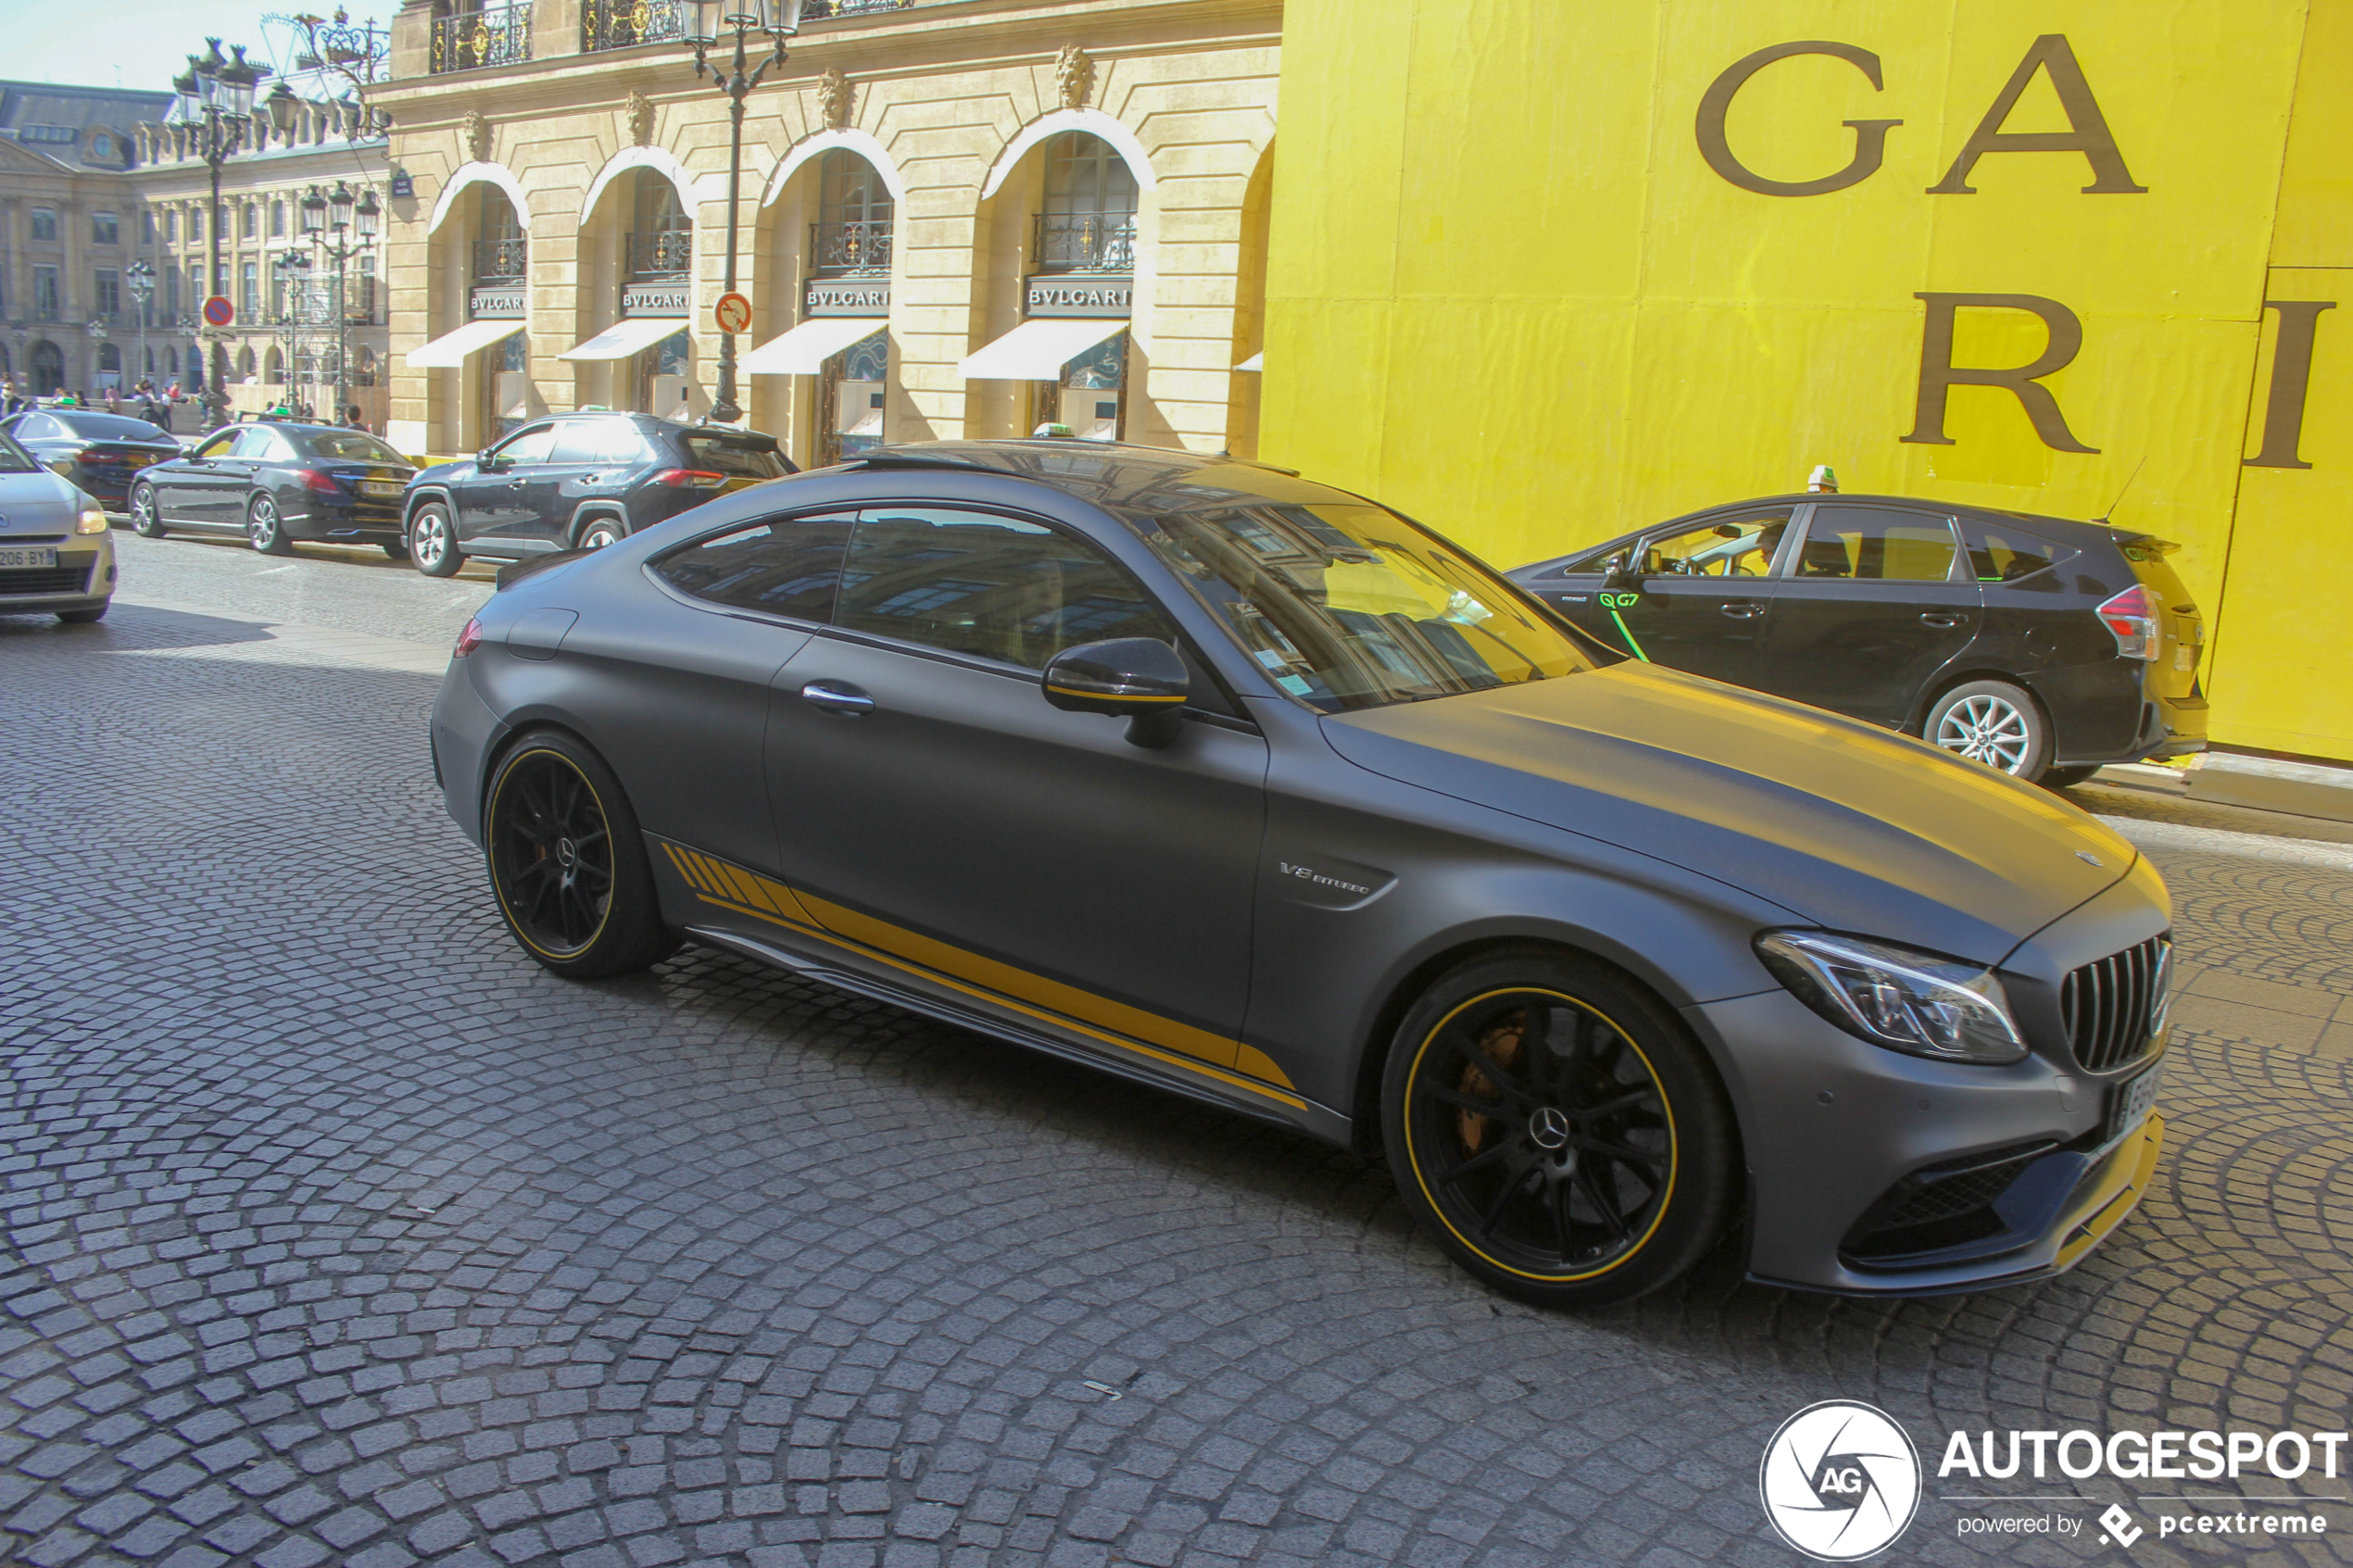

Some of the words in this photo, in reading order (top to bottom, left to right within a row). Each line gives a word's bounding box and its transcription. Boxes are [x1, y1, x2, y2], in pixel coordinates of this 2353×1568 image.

[1695, 33, 2149, 197] GA
[623, 294, 690, 307] BVLGARI
[807, 291, 888, 305] BVLGARI
[1028, 289, 1127, 304] BVLGARI
[1899, 291, 2338, 470] RI
[1616, 593, 1640, 608] G7
[1280, 861, 1313, 879] V8
[1313, 874, 1369, 895] BITURBO
